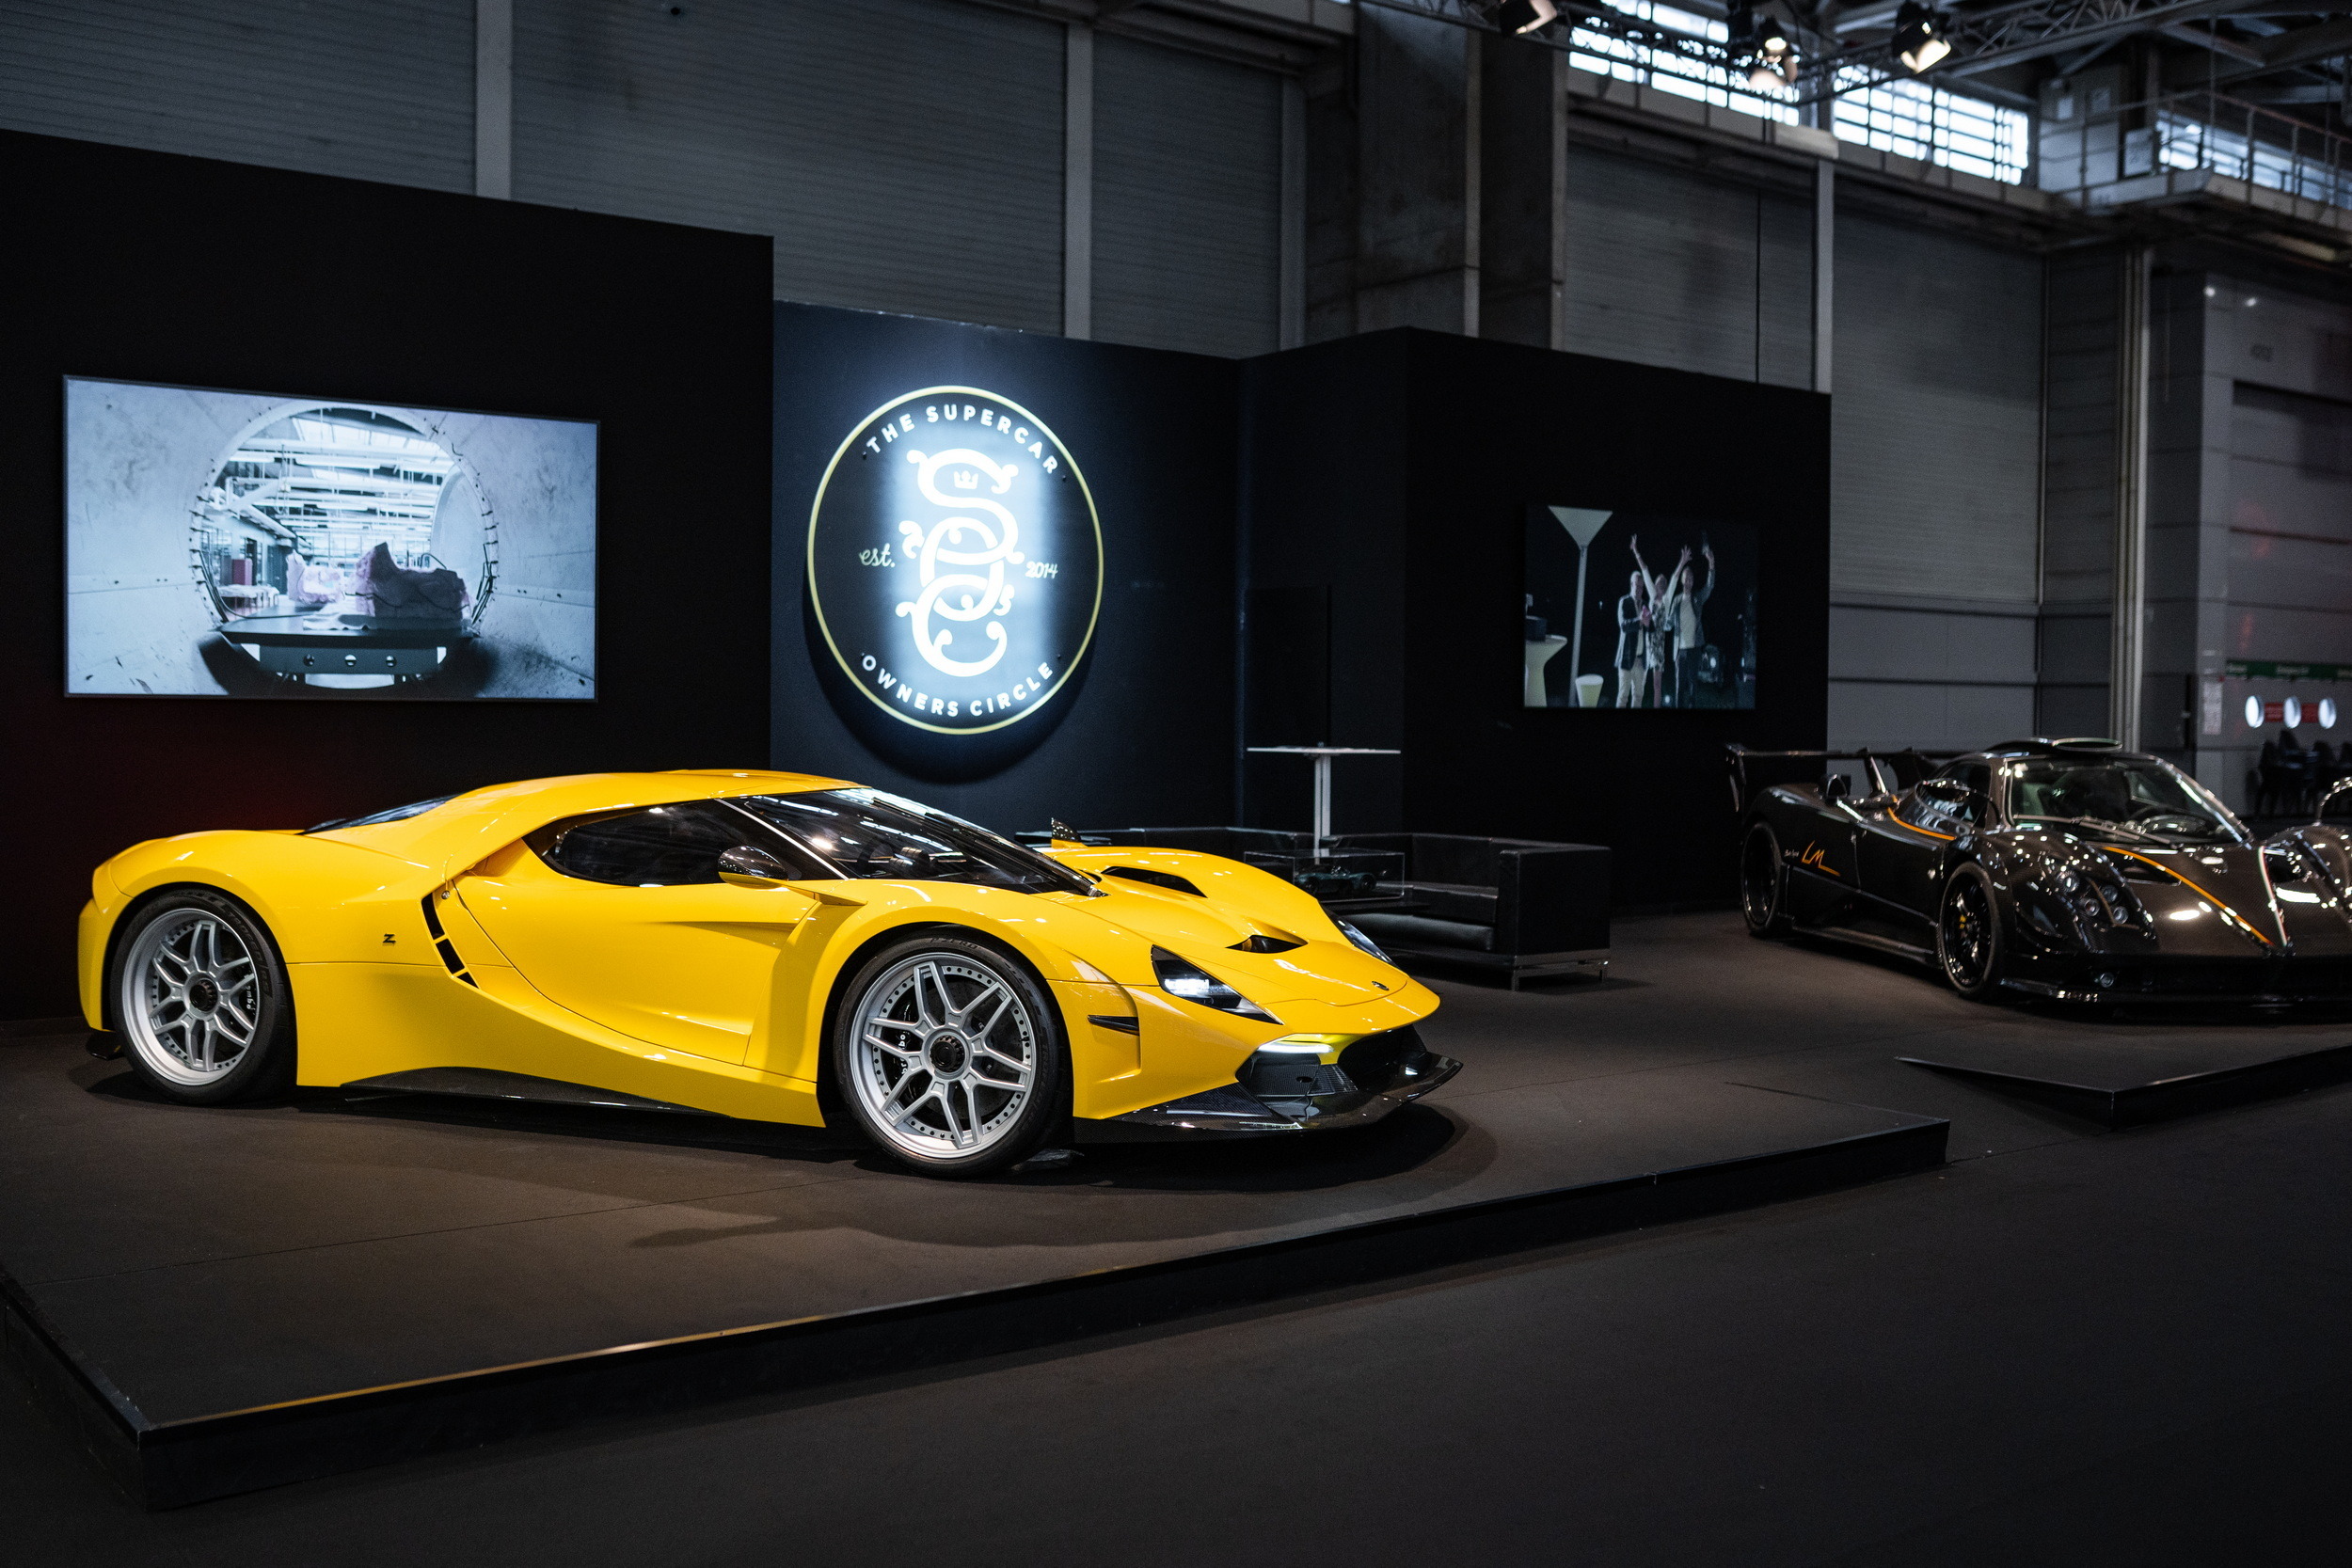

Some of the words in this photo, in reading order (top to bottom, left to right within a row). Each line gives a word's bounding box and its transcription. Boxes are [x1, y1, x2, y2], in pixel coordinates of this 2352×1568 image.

[866, 413, 915, 453] THE
[926, 404, 1058, 474] SUPERCAR
[858, 543, 896, 568] est.
[1025, 561, 1058, 579] 2014
[862, 655, 959, 718] OWNERS
[970, 662, 1054, 717] CIRCLE
[382, 933, 397, 944] Z
